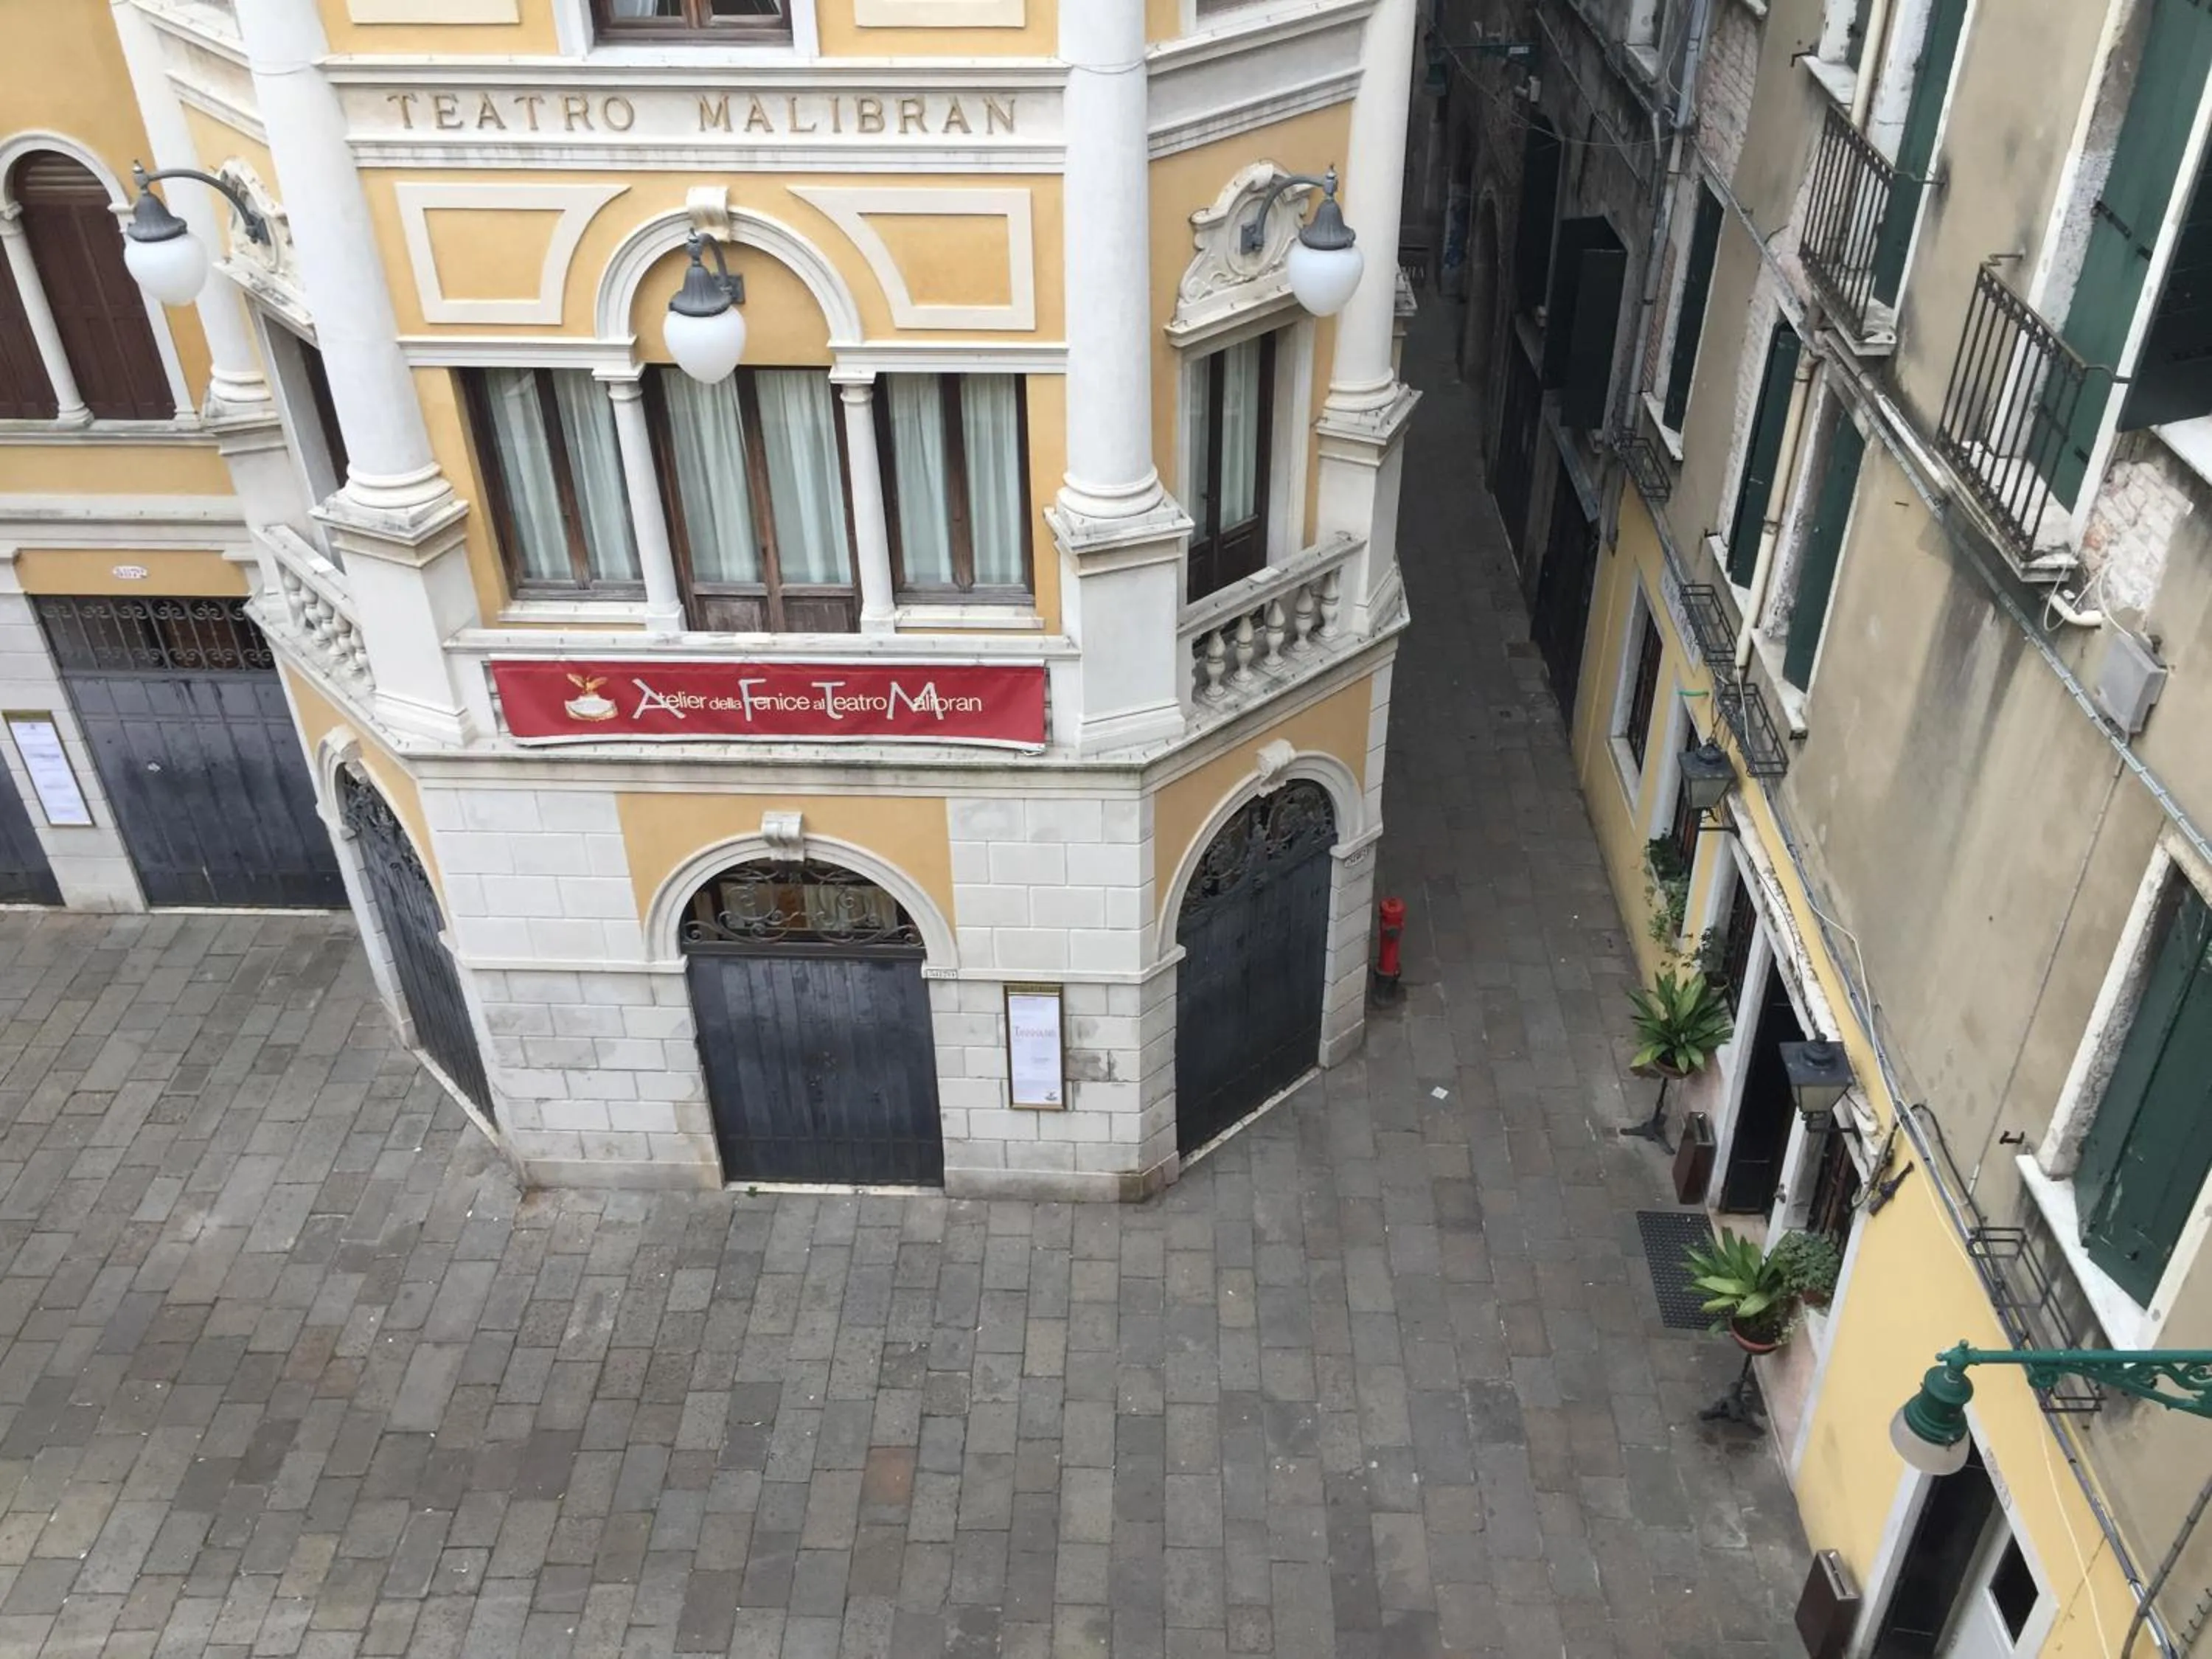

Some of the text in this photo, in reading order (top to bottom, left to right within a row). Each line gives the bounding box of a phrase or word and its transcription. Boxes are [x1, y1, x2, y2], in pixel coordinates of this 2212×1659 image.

[387, 93, 1015, 134] TEATRO MALIBRAN
[632, 678, 982, 722] Atelier della Fenice al Teatro Malibran
